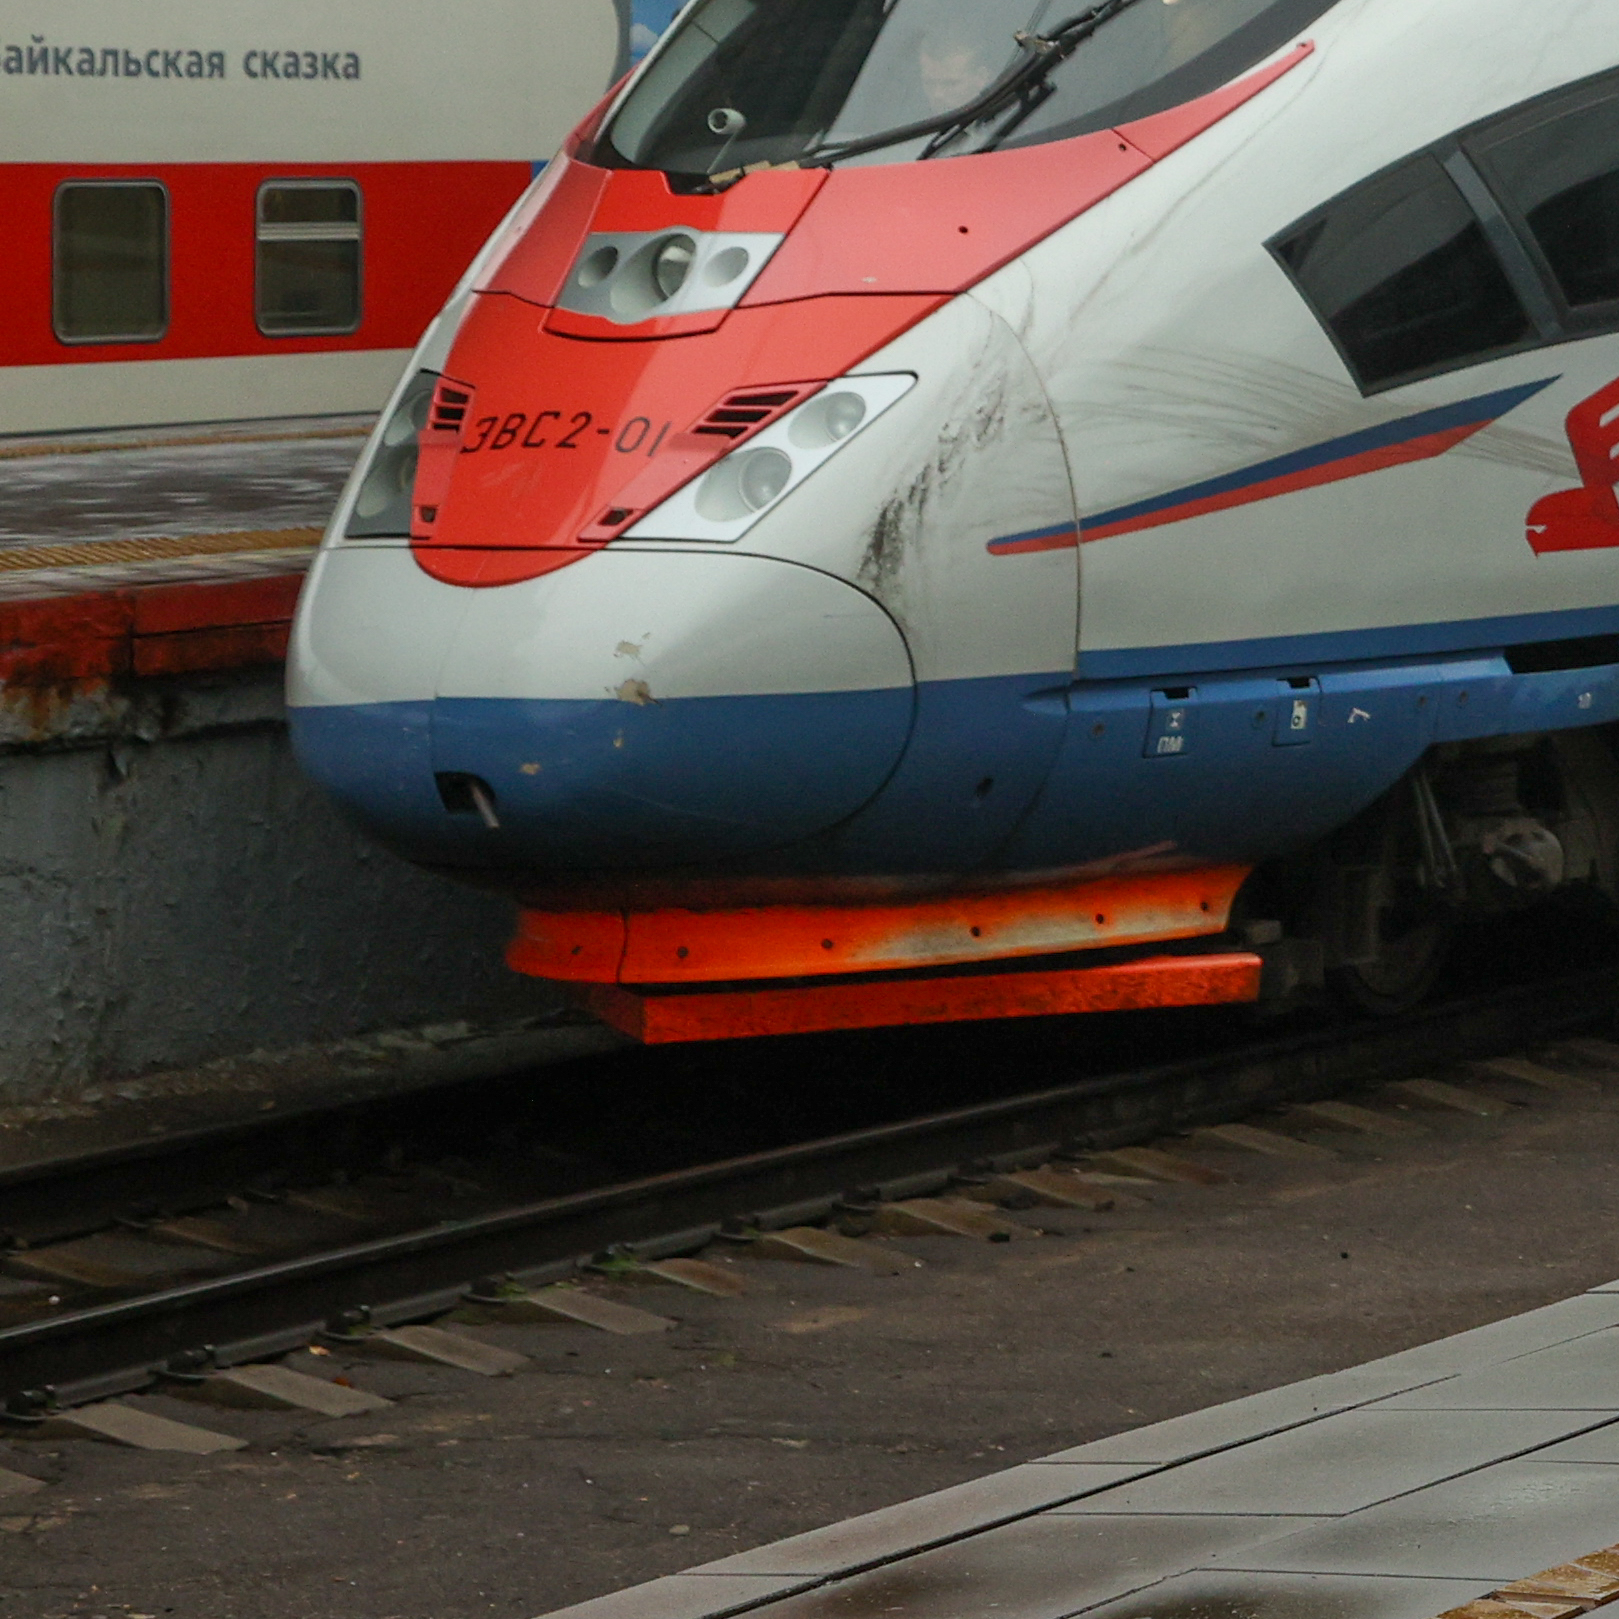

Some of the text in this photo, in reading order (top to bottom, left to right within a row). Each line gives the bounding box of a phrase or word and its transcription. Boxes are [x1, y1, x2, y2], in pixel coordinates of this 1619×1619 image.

[2, 34, 361, 79] айкальская сказка
[460, 410, 672, 457] ЭВС2-01
